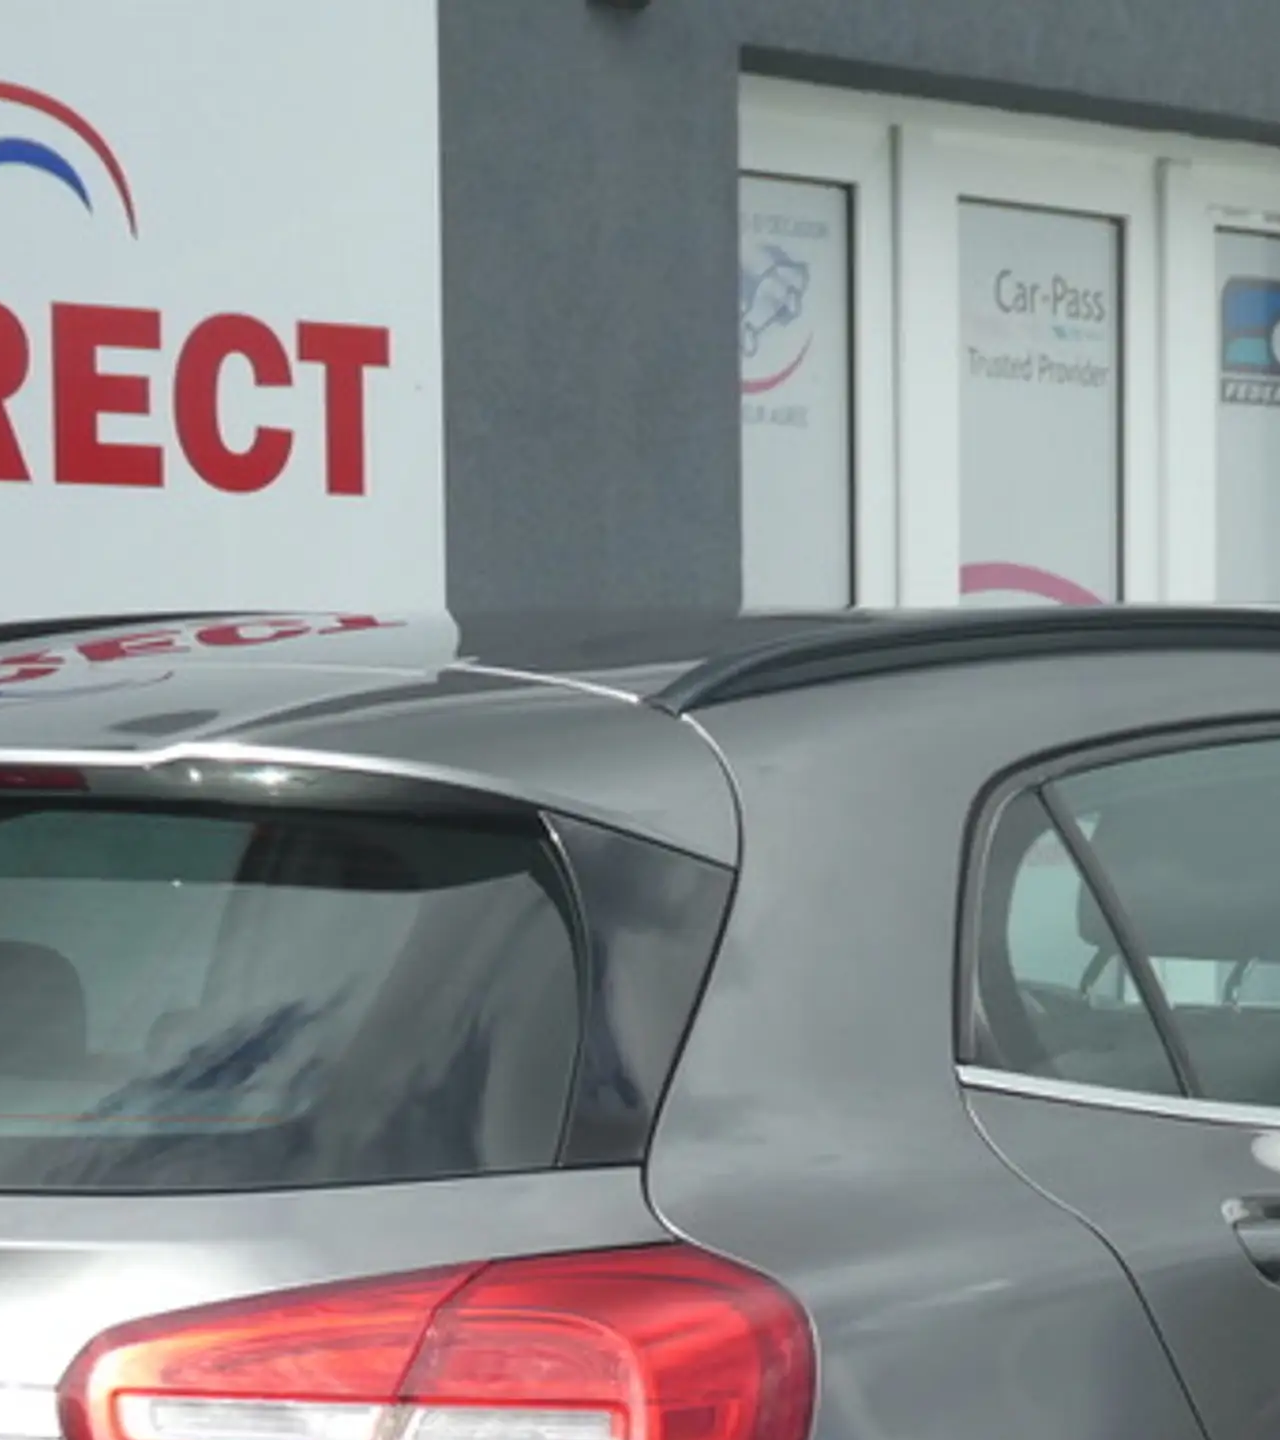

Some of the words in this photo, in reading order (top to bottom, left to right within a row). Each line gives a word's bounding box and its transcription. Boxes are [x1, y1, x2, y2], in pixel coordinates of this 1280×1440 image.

[993, 268, 1107, 323] Car-Pass
[968, 346, 1032, 382] Trusted
[1038, 353, 1109, 388] Provider
